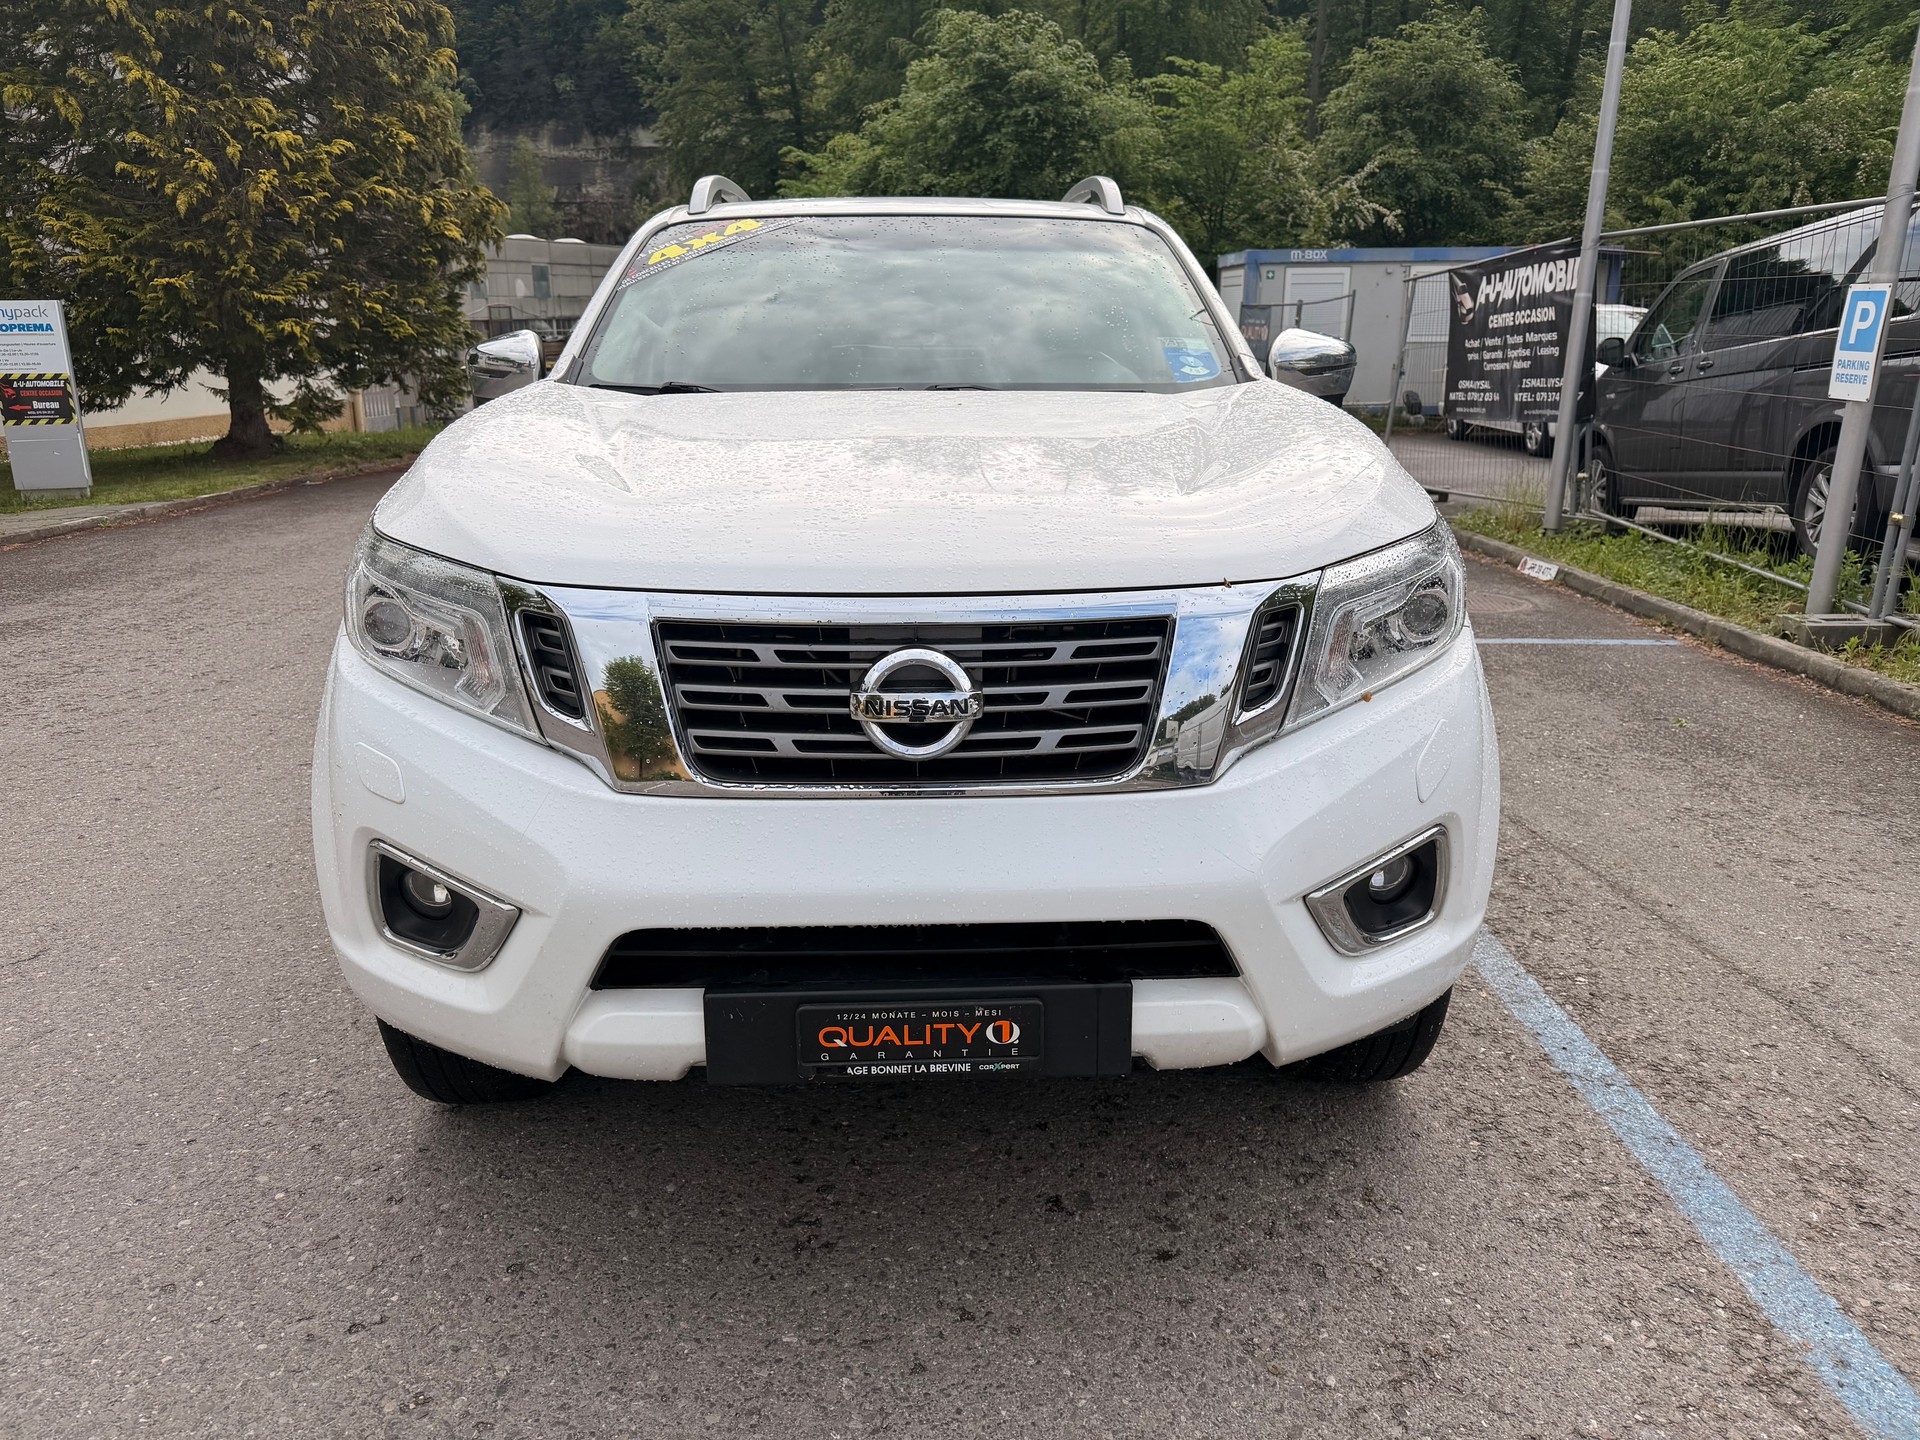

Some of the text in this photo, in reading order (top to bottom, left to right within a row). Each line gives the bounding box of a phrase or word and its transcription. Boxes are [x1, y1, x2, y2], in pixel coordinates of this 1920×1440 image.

[1488, 306, 1556, 329] CENTRE OCCASION
[1849, 301, 1876, 344] P
[1525, 331, 1558, 343] Marques
[1536, 345, 1560, 356] Leasing
[1837, 359, 1870, 371] PARKING
[1835, 373, 1868, 385] RESERVE
[32, 400, 60, 409] Bureau
[864, 699, 968, 716] NISSAN
[872, 1011, 916, 1019] MONATE
[932, 1010, 960, 1018] MOIS
[975, 1009, 1002, 1017] MESI
[818, 1022, 982, 1048] QUALITY
[820, 1047, 1019, 1061] GARANTIE
[871, 1065, 912, 1074] BONNET
[914, 1064, 927, 1073] LA
[930, 1063, 972, 1073] BREVINE
